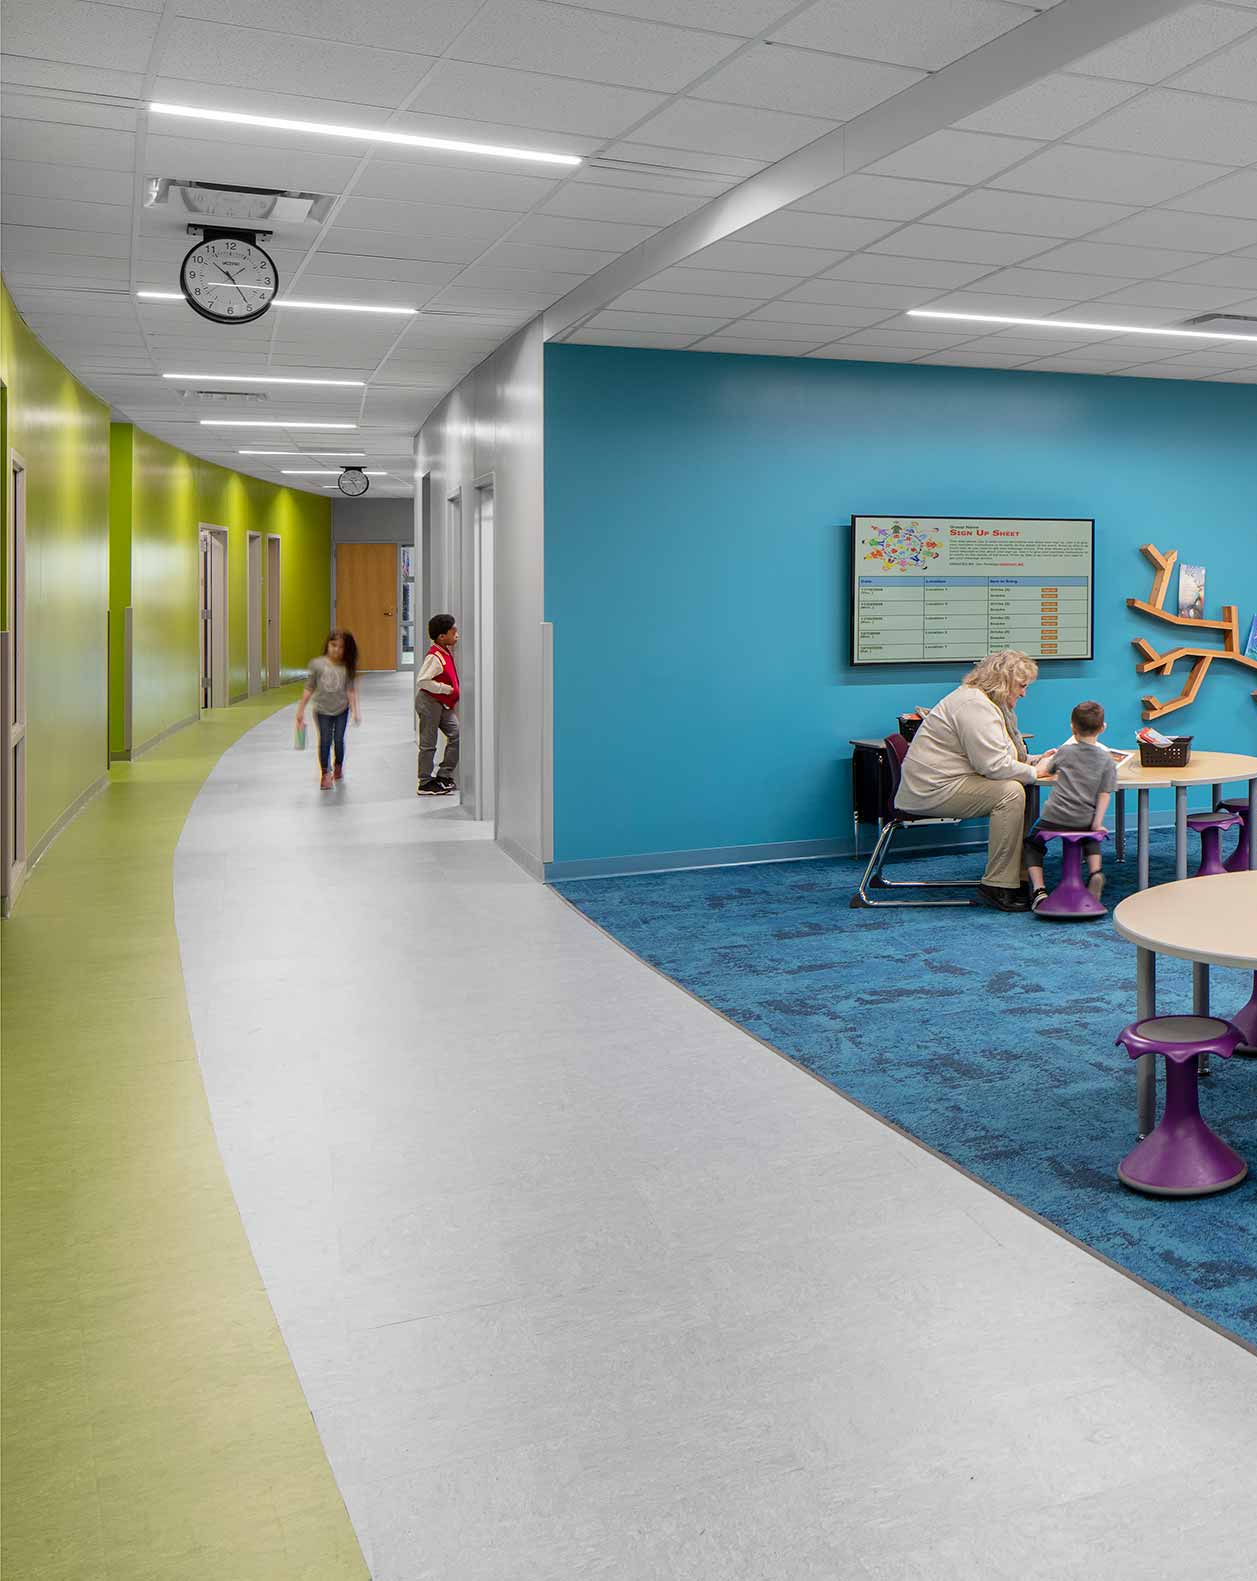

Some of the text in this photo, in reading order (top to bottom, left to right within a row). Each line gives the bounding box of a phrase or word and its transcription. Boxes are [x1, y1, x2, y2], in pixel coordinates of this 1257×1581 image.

[206, 245, 216, 254] 11
[225, 242, 237, 251] 12
[247, 248, 252, 256] 1
[192, 255, 204, 264] 10
[260, 260, 267, 270] 2
[189, 270, 196, 279] 9
[264, 276, 271, 285] 3
[194, 287, 201, 296] 8
[259, 292, 266, 300] 4
[207, 300, 214, 309] 7
[246, 303, 253, 312] 5
[227, 306, 234, 315] 6
